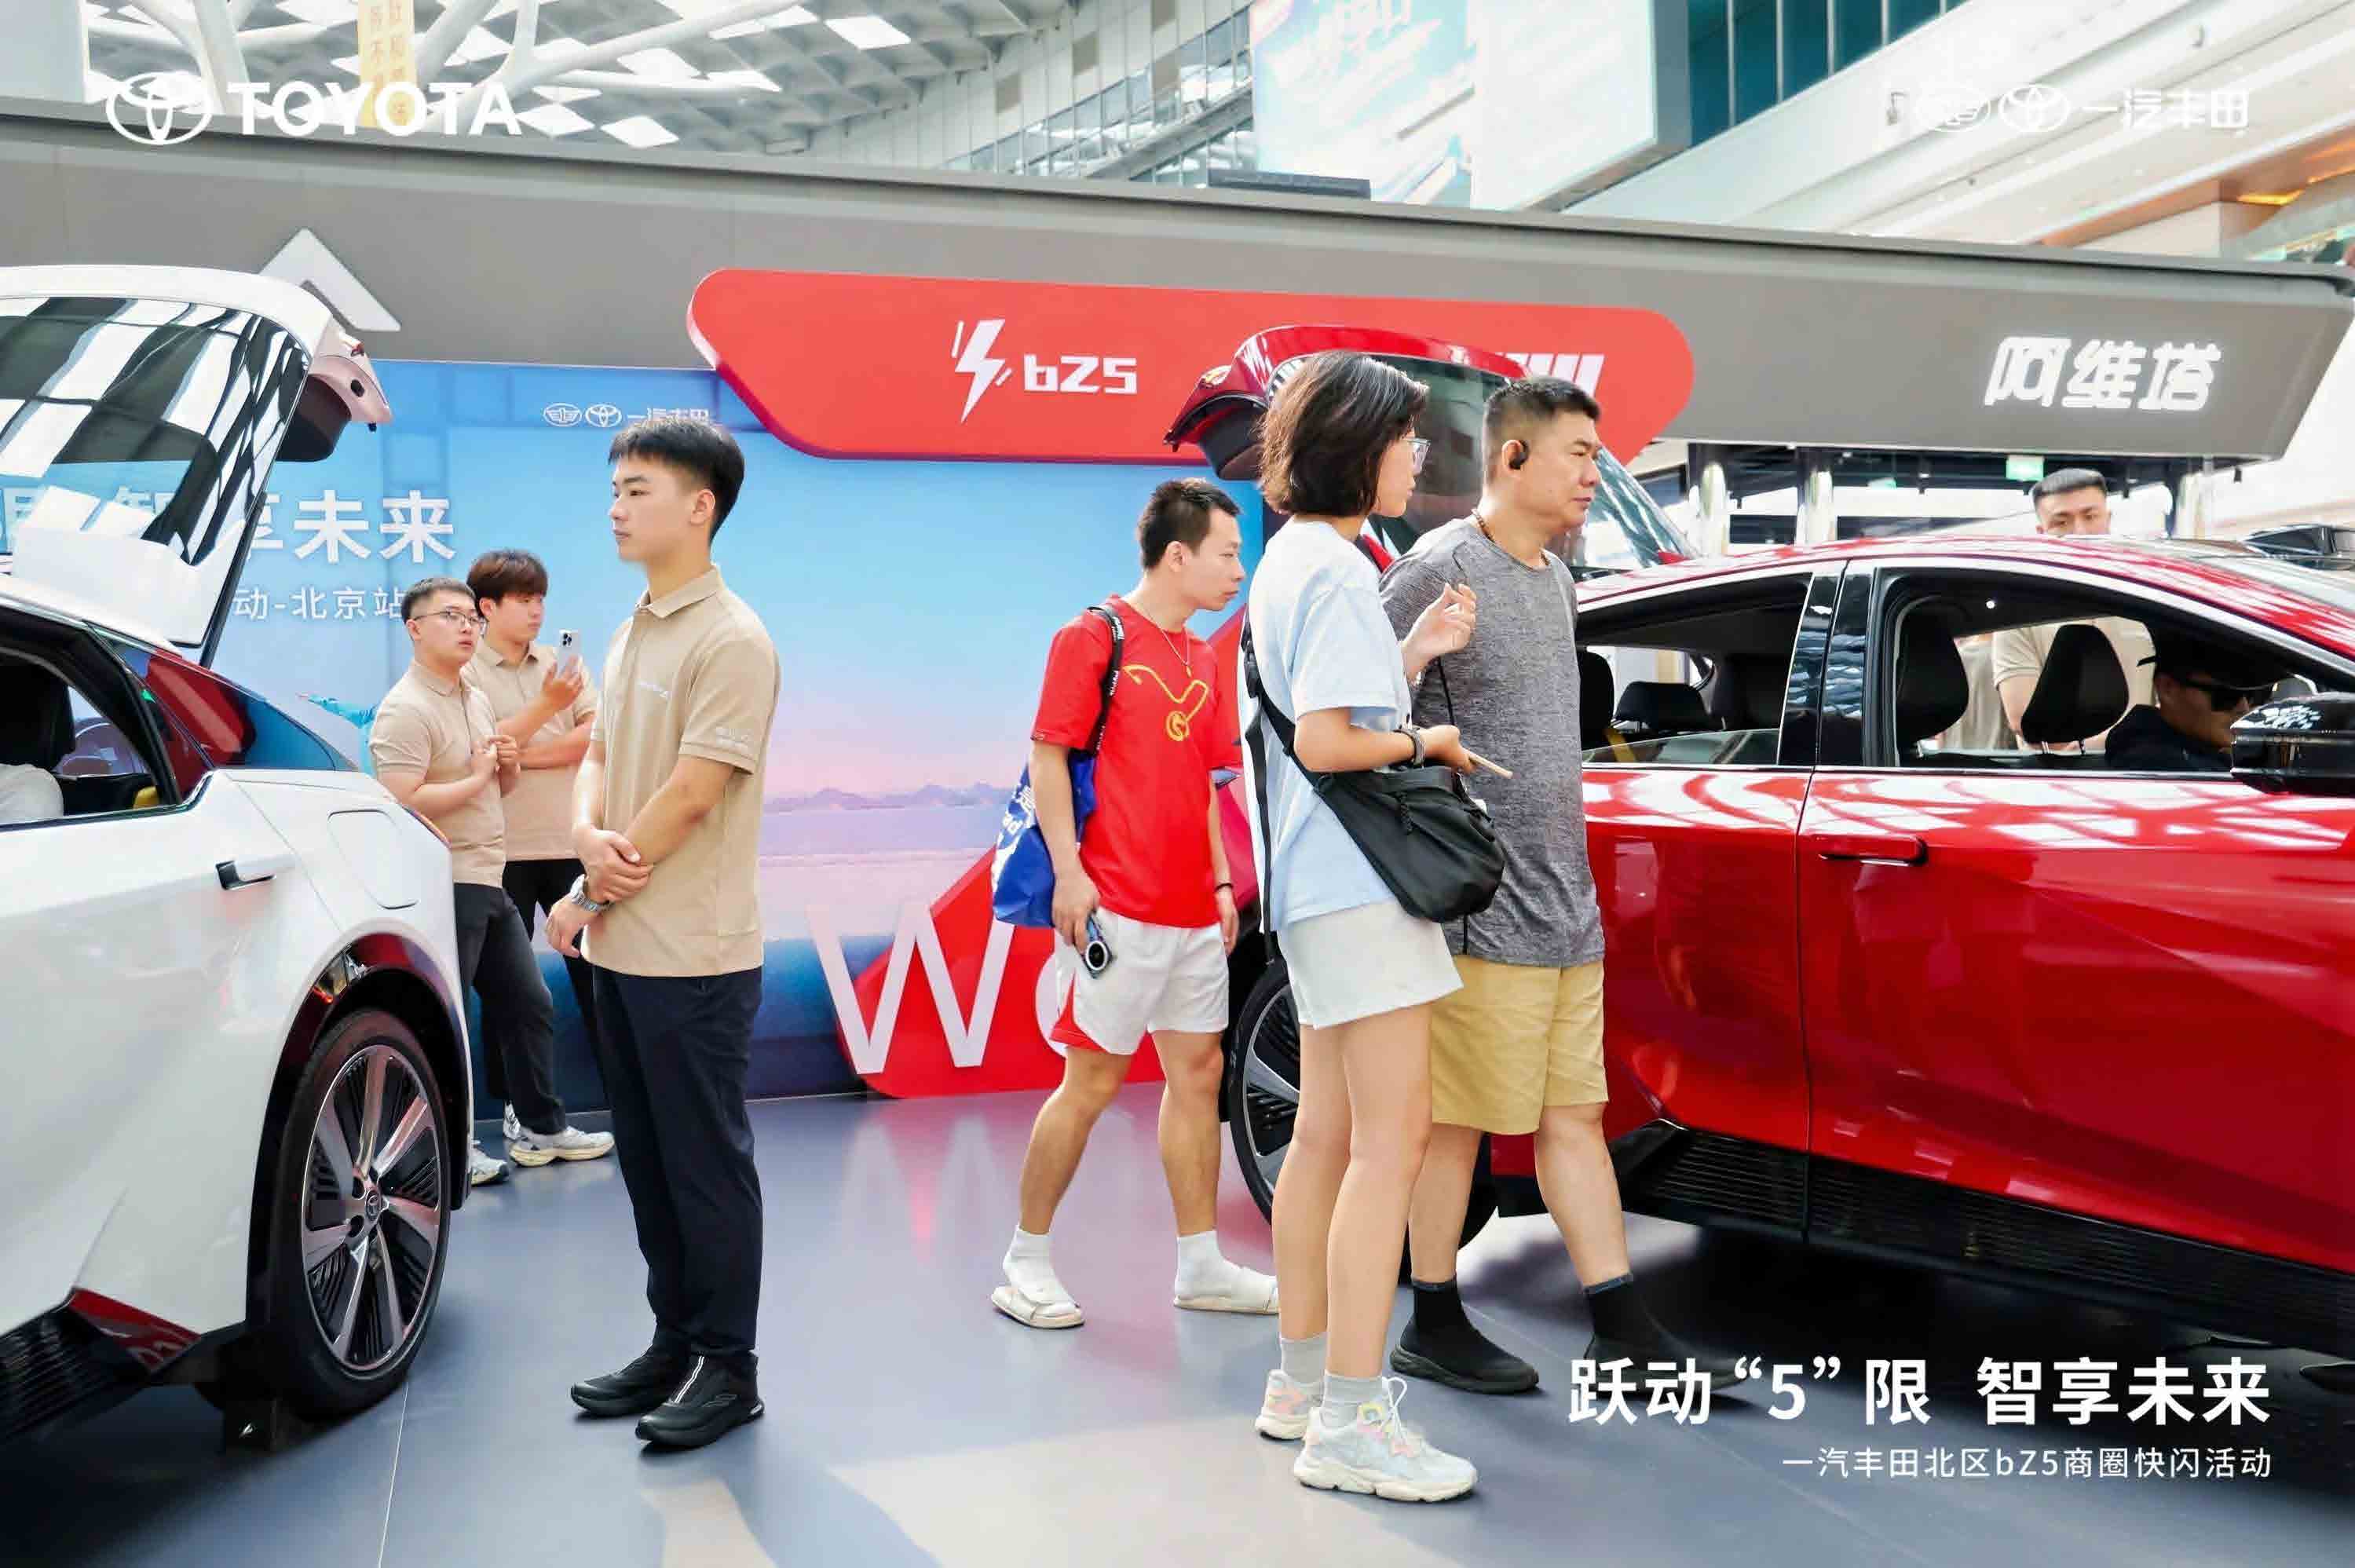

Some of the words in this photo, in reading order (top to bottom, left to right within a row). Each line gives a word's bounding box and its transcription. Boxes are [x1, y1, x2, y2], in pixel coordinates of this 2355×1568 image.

[1024, 354, 1138, 394] bZ5
[1984, 335, 2222, 411] 阿维塔
